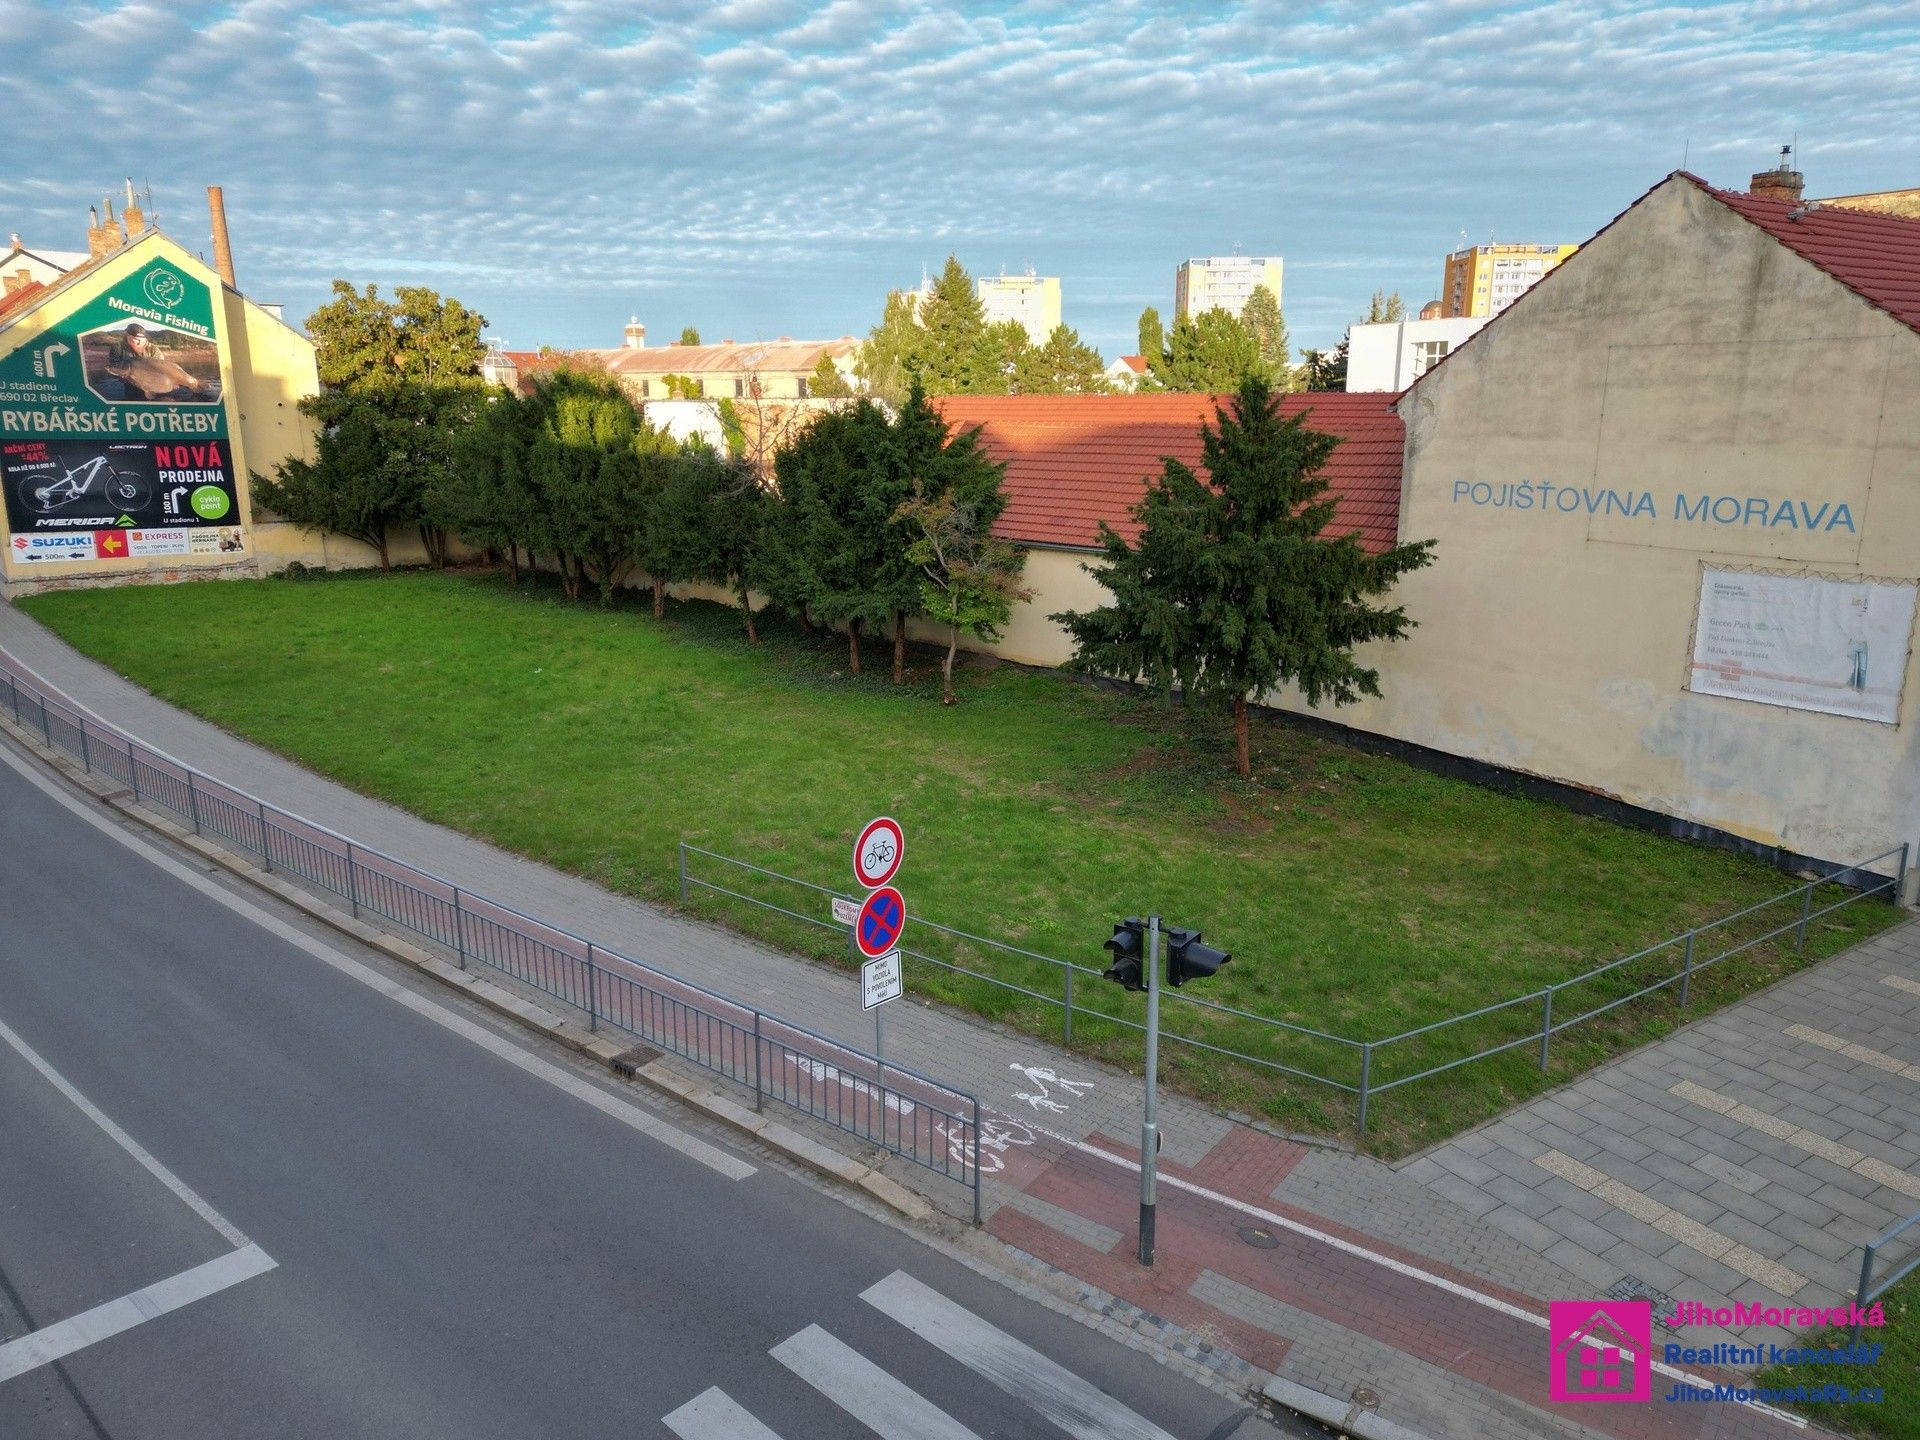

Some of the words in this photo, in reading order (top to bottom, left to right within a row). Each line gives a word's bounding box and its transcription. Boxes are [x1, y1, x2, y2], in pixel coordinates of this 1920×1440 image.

[108, 296, 162, 321] Moravia
[165, 313, 209, 336] Fishing
[34, 350, 42, 359] m
[34, 361, 44, 377] 400
[9, 381, 57, 391] stadionu
[0, 392, 20, 402] 690
[23, 393, 38, 402] 02
[40, 393, 79, 403] Břeclav
[2, 406, 120, 432] RYBÁŘSKÉ
[125, 407, 219, 432] POTŘEBY
[155, 441, 222, 468] NOVÁ
[159, 470, 224, 483] PRODEJNA
[163, 492, 170, 500] m
[199, 495, 220, 504] cyklo
[163, 501, 172, 514] 100
[200, 502, 221, 511] point
[1452, 479, 1657, 518] POJIŠŤOVNA
[1674, 494, 1856, 533] MORAVA
[35, 516, 115, 527] MERIDA
[32, 536, 91, 548] SUZUKI
[145, 532, 184, 541] EXPRESS
[874, 961, 888, 971] MIMO
[872, 969, 891, 981] VOZIDLA
[871, 976, 897, 992] POVOLENÍM
